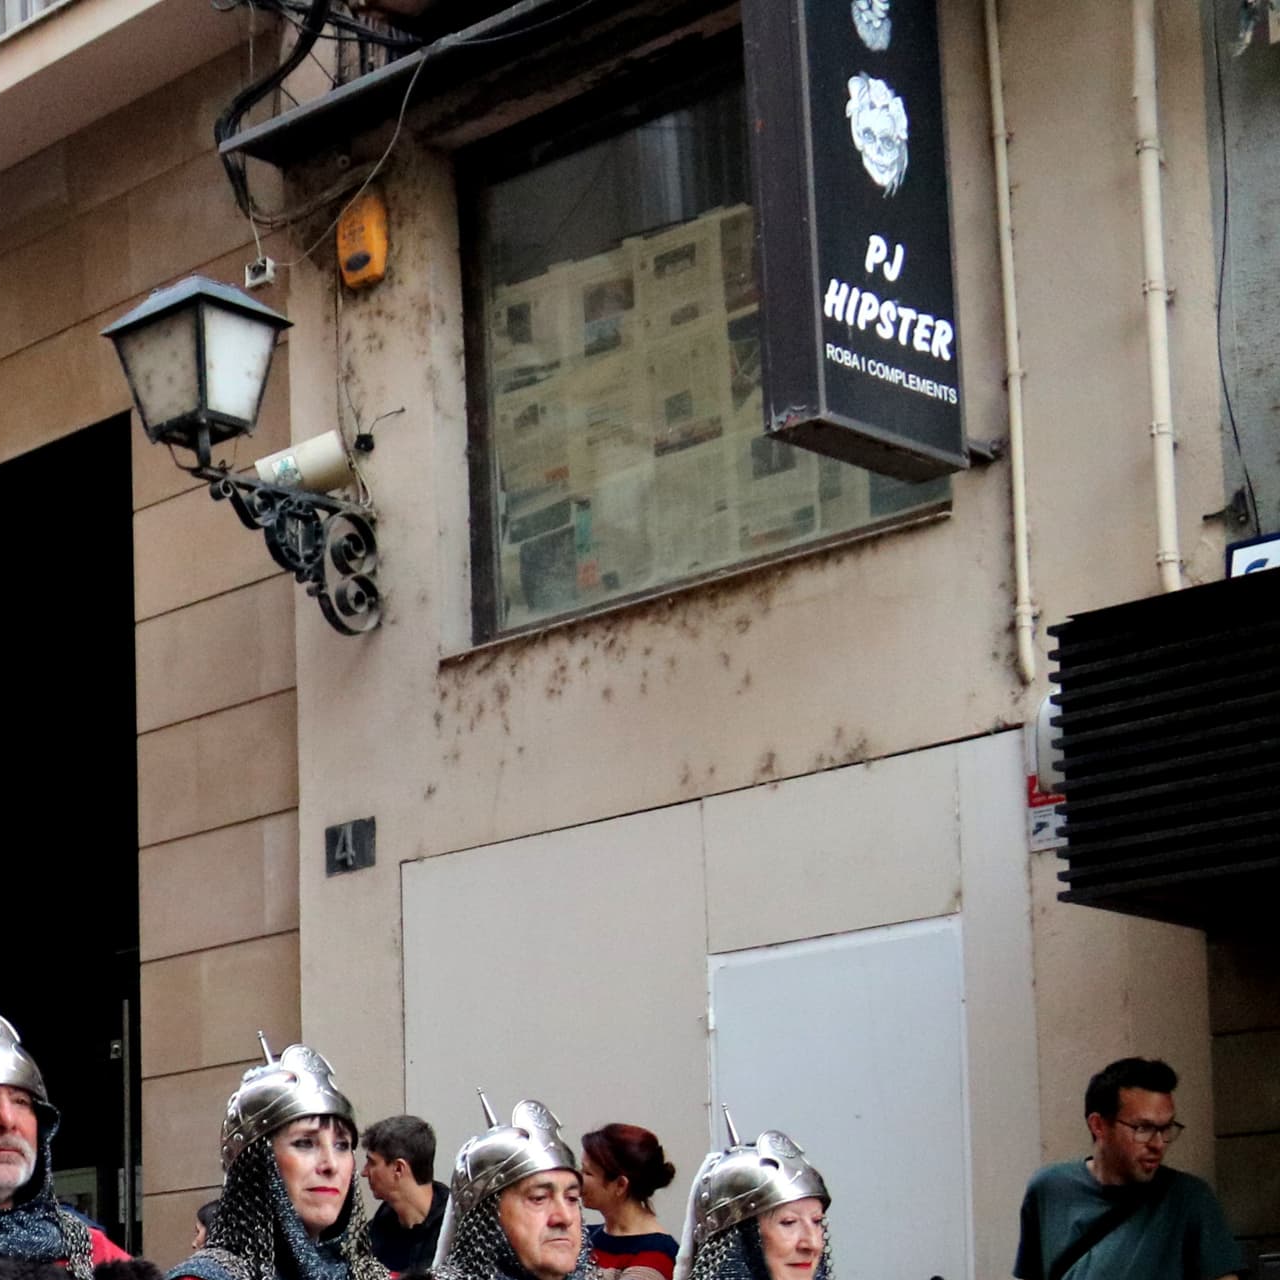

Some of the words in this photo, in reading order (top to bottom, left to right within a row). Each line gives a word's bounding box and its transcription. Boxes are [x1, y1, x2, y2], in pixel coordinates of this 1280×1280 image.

[864, 234, 905, 282] PJ
[823, 278, 955, 361] HIPSTER
[825, 342, 860, 371] ROBA
[867, 359, 958, 405] COMPLEMENTS
